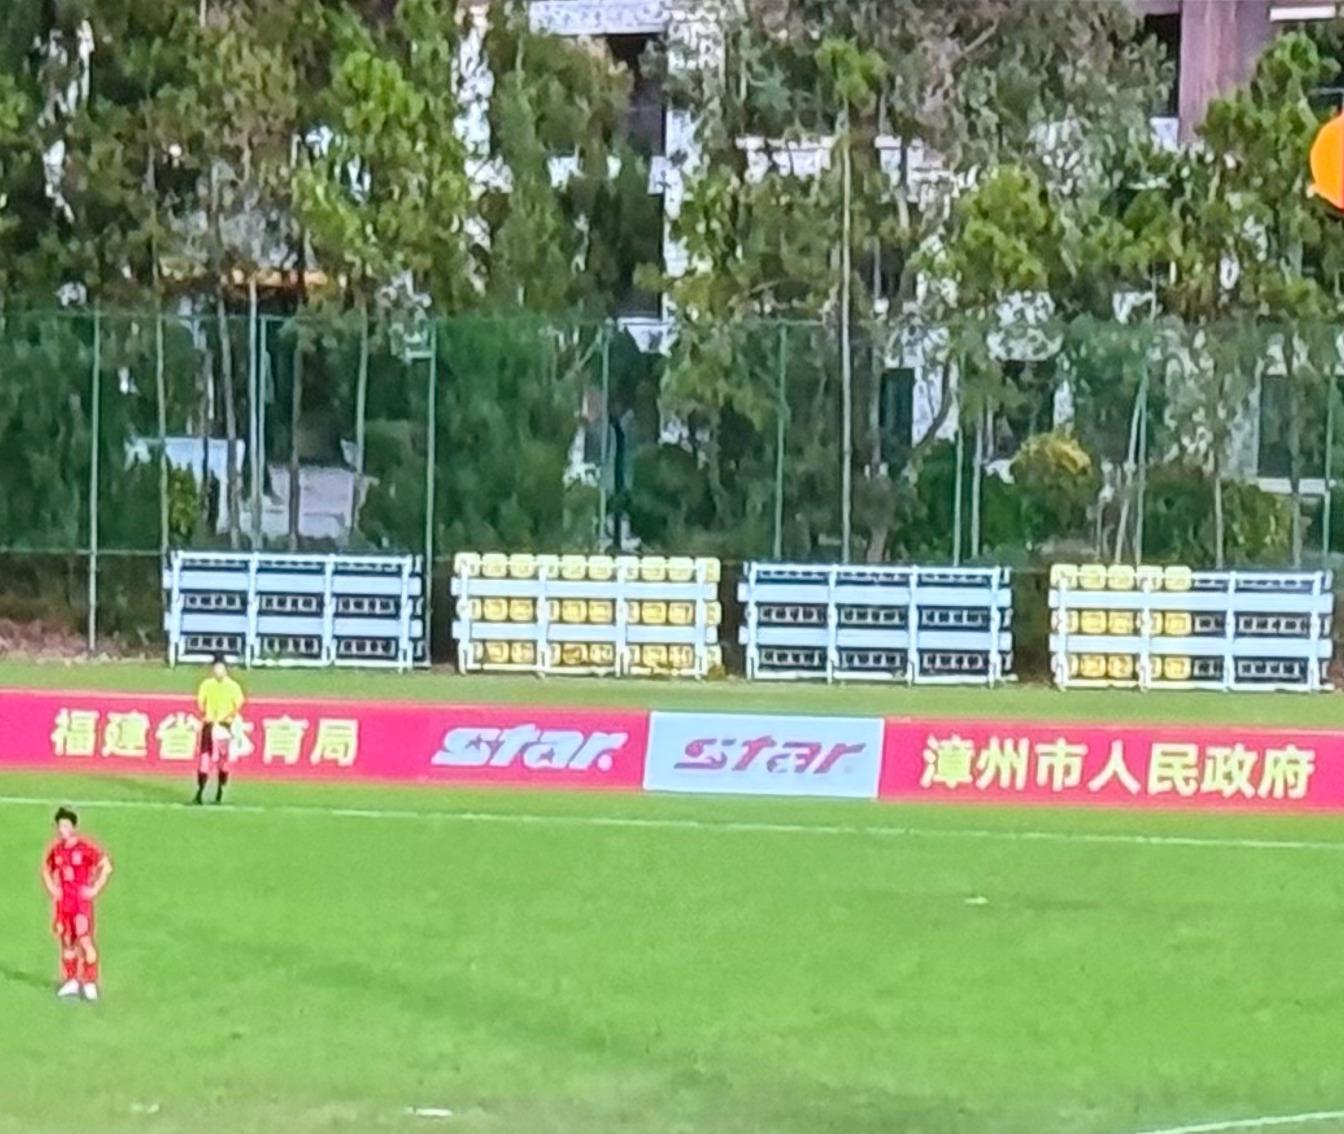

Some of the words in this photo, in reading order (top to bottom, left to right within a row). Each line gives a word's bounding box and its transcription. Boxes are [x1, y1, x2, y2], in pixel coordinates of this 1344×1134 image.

[919, 735, 1316, 799] 漳州市人民政府
